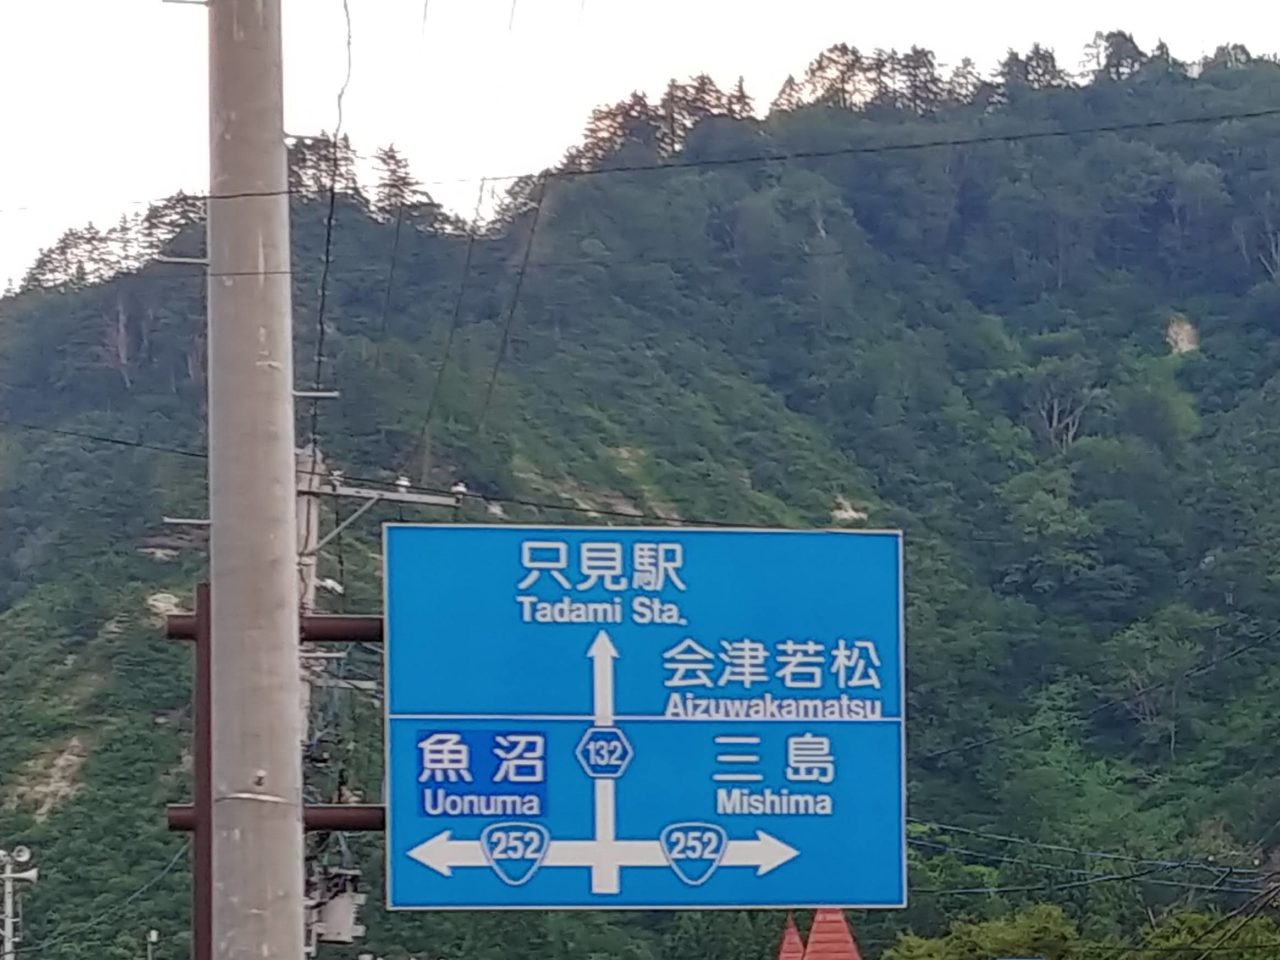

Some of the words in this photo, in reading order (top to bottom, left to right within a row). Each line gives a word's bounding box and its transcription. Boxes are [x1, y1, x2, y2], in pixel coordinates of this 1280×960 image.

[517, 540, 687, 592] 只見駅
[517, 596, 622, 625] Tadami
[631, 596, 688, 626] Sta.
[662, 638, 882, 690] 会津若松
[664, 693, 882, 720] Aizuwakamatsu
[418, 734, 546, 784] 魚沼
[586, 739, 623, 766] 132
[712, 732, 836, 784] 三島
[422, 787, 541, 817] Uonuma
[716, 788, 833, 816] Mishima
[490, 833, 542, 861] 252
[668, 832, 720, 860] 252
